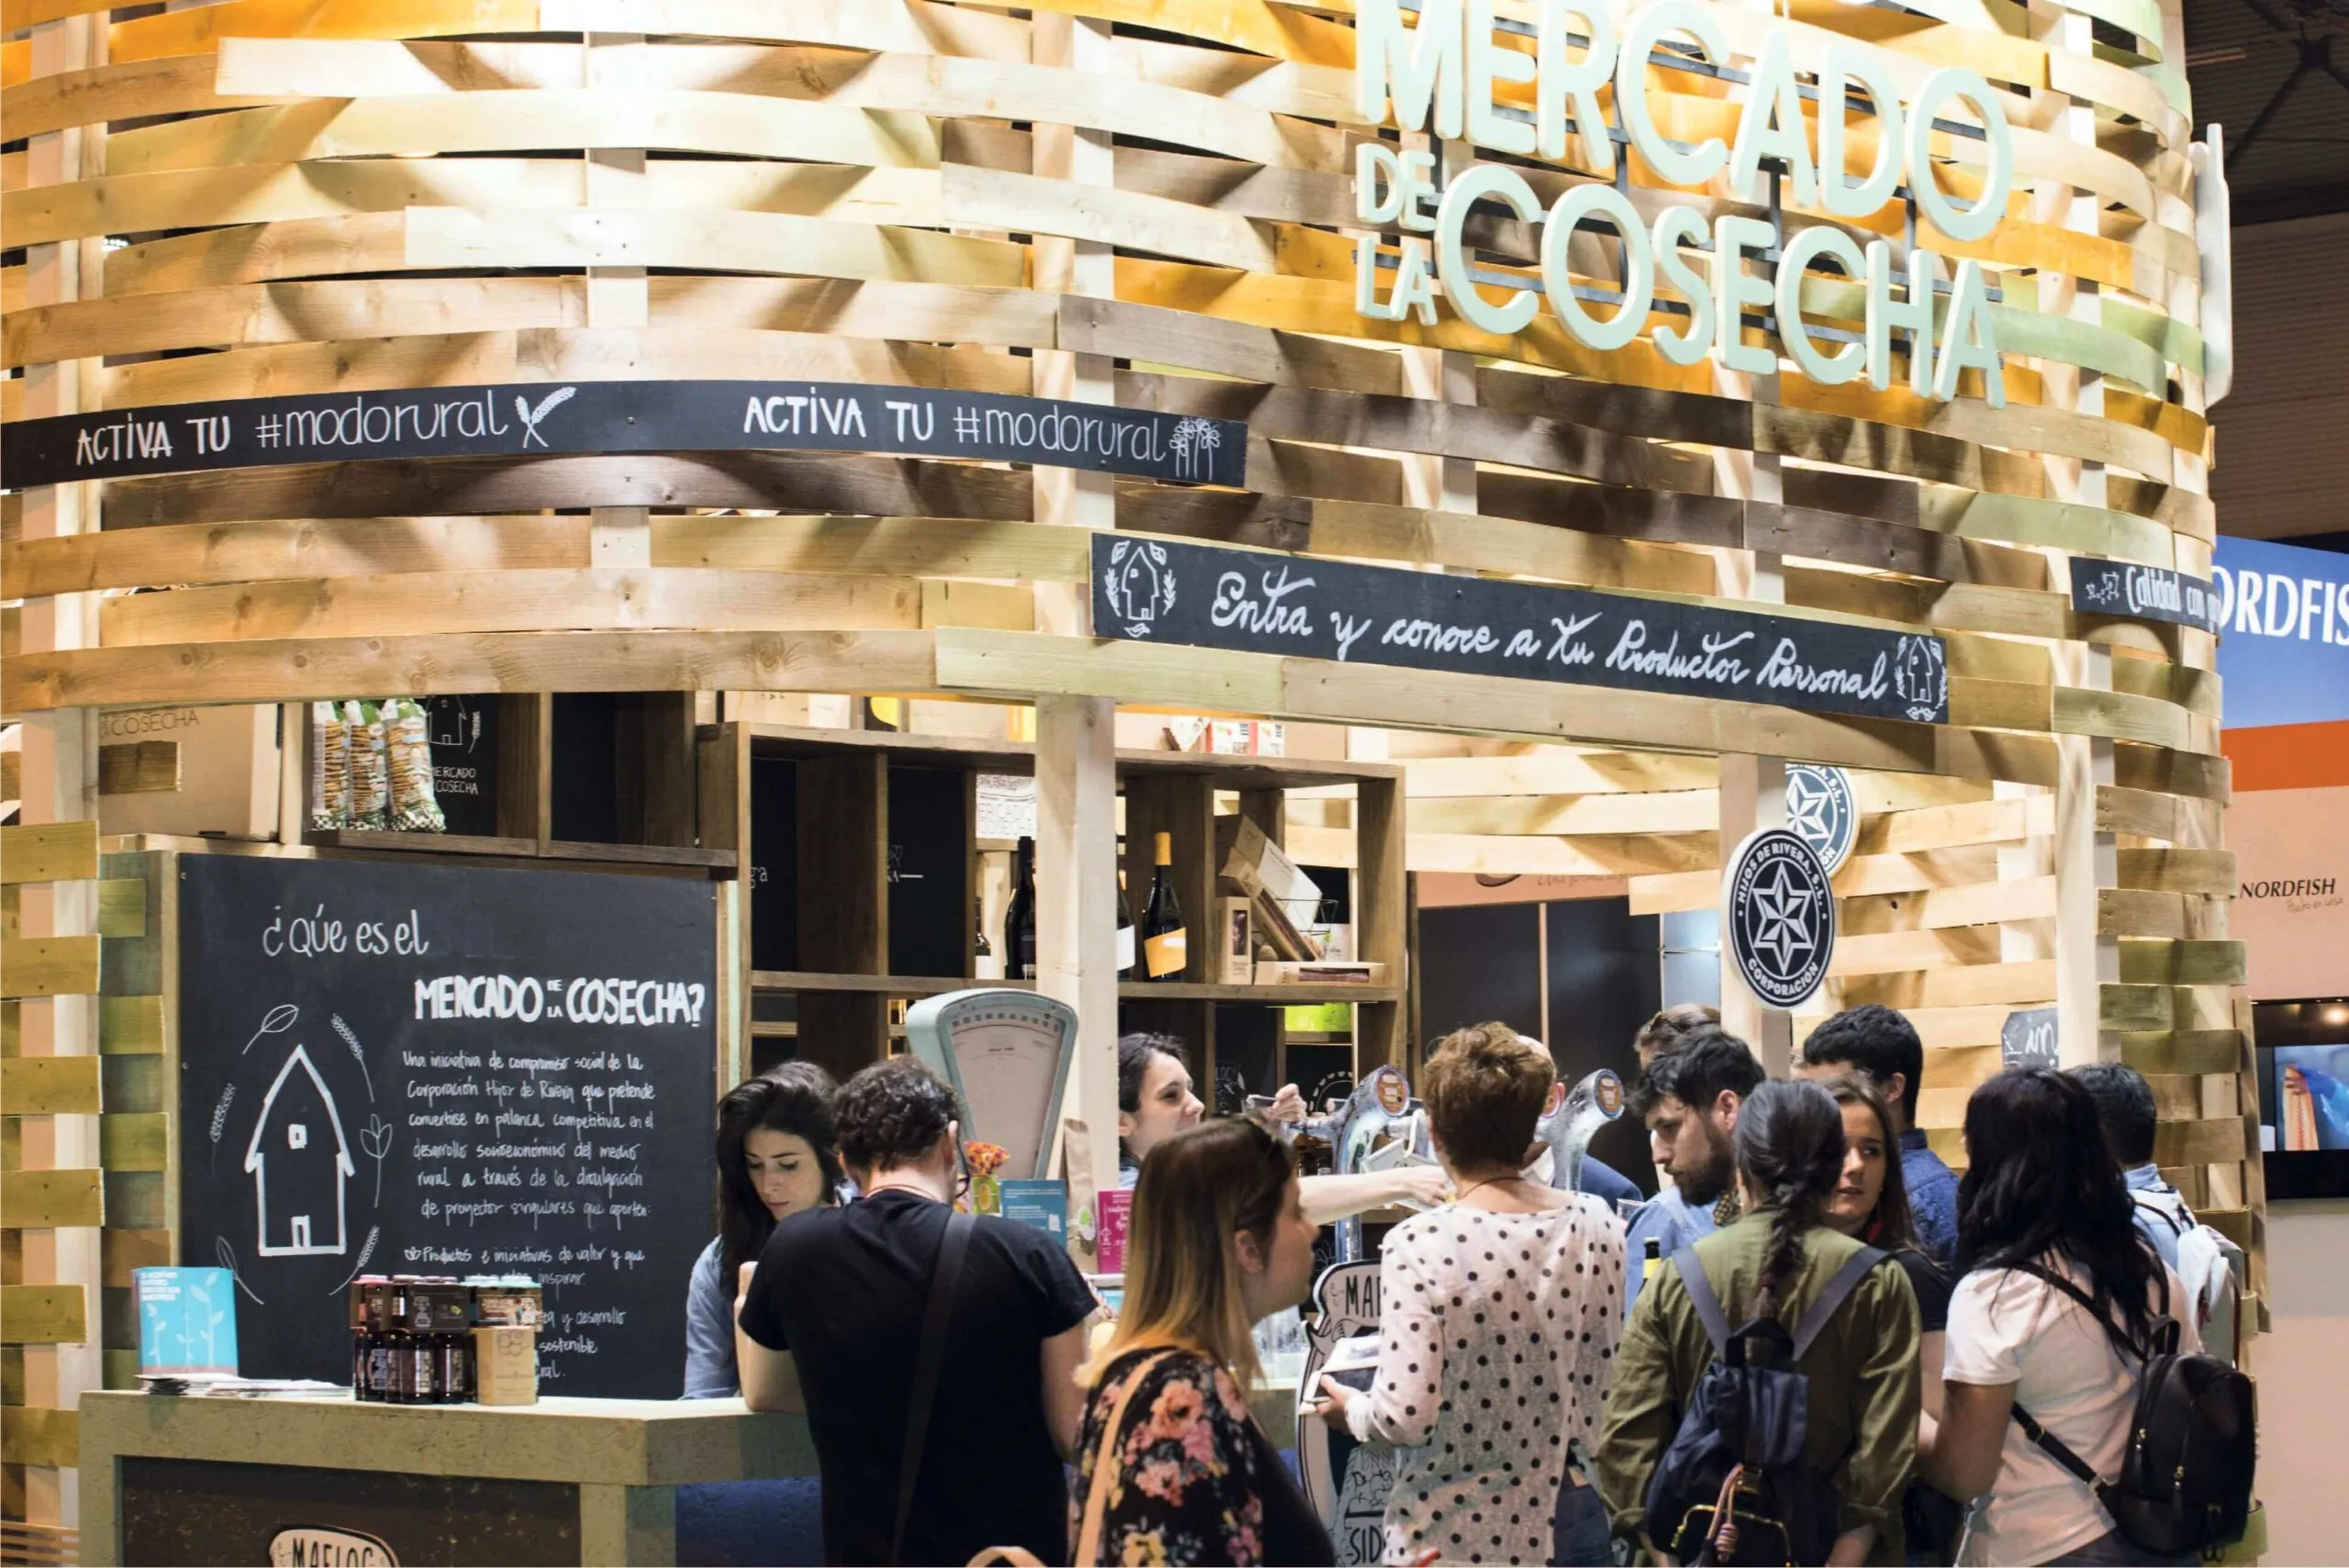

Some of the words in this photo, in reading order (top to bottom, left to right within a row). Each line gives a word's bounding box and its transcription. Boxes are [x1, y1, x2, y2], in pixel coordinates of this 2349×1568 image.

[1356, 0, 2011, 241] MERCADO
[1356, 143, 1437, 232] DE
[1355, 236, 1438, 326] LA
[1434, 165, 2006, 410] COSECHA
[187, 416, 231, 454] TU
[255, 389, 508, 448] #modorural
[885, 401, 934, 442] TU
[952, 403, 1167, 462] #modorural
[2124, 565, 2182, 614] Calidad
[2210, 565, 2349, 645] ORDFIS
[1211, 565, 1316, 637] Entra
[1330, 611, 1372, 662] y
[1382, 618, 1500, 655] conoce
[1504, 627, 1542, 658] a
[1605, 618, 1754, 684] Productor
[1756, 638, 1888, 700] Personal
[112, 708, 199, 736] COSECHA
[1738, 858, 1758, 905] HIJOS
[1755, 847, 1772, 865] DE
[2240, 878, 2336, 899] NORDFISH
[355, 918, 389, 955] es
[395, 908, 429, 955] el
[415, 974, 545, 1023] MERCADO
[547, 979, 562, 991] DE
[565, 977, 706, 1028] COSECHA?
[547, 1006, 562, 1018] LA
[403, 1051, 426, 1068] Una
[430, 1051, 482, 1069] iniciativa
[488, 1051, 504, 1069] de
[573, 1051, 606, 1069] social
[607, 1053, 621, 1072] de
[627, 1053, 643, 1071] la
[406, 1075, 478, 1108] Corporación
[519, 1081, 535, 1098] de
[582, 1082, 605, 1111] que
[607, 1081, 656, 1114] pretende
[474, 1112, 490, 1125] en
[495, 1108, 546, 1139] palanca
[552, 1112, 628, 1140] competitiva
[629, 1116, 642, 1129] en
[644, 1111, 653, 1129] el
[413, 1138, 470, 1160] desarrollo
[573, 1140, 592, 1160] del
[417, 1167, 452, 1187] rural
[462, 1173, 476, 1187] a
[483, 1165, 522, 1187] través
[529, 1167, 548, 1186] de
[553, 1169, 571, 1187] la
[421, 1198, 440, 1218] de
[510, 1199, 575, 1230] singulares
[583, 1204, 604, 1229] que
[422, 1247, 473, 1264] Productos
[481, 1251, 490, 1264] e
[494, 1248, 552, 1264] iniciativas
[558, 1245, 573, 1264] de
[577, 1243, 607, 1262] valor
[610, 1249, 622, 1270] y
[624, 1249, 645, 1270] que
[562, 1315, 573, 1332] y
[576, 1307, 627, 1326] desarrollo
[539, 1335, 598, 1354] sostenible
[1350, 1525, 1383, 1565] SID
